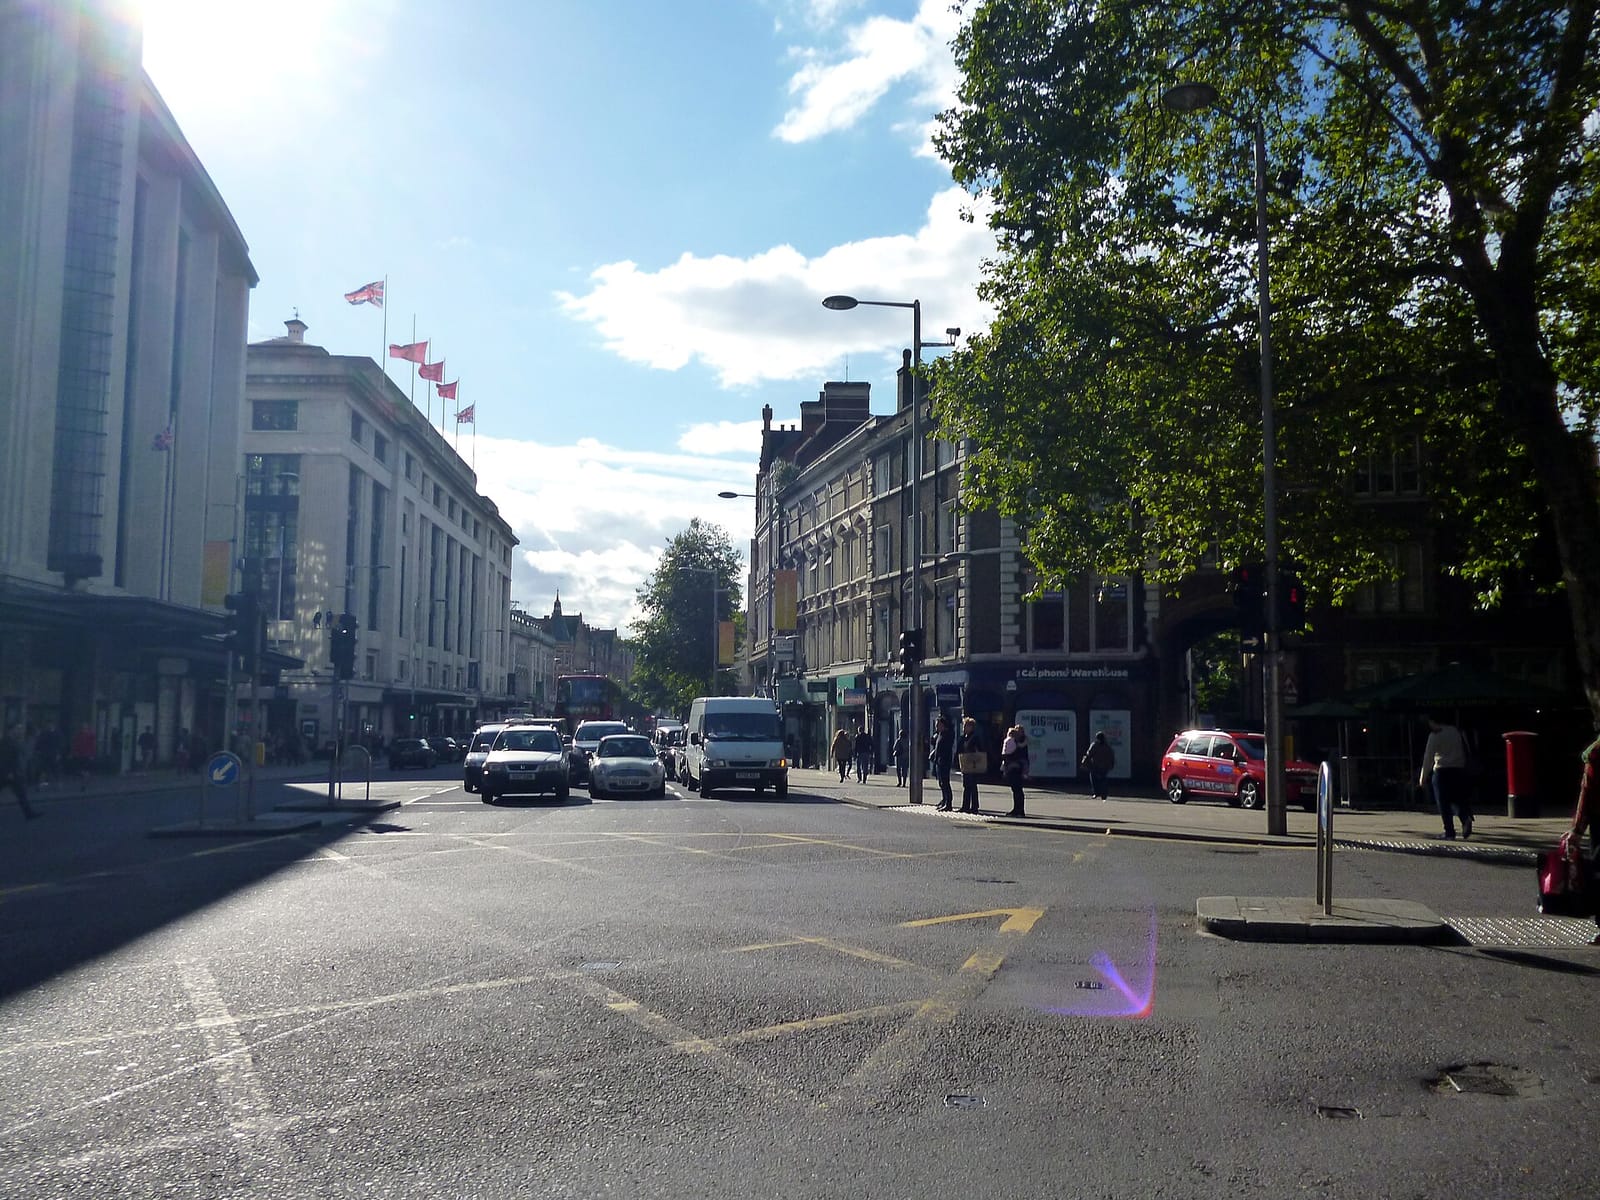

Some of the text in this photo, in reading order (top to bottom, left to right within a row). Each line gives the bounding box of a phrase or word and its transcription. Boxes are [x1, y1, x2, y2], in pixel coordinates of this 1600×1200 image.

[1071, 668, 1129, 678] Warehouse
[1030, 714, 1047, 727] BIG
[1053, 720, 1070, 732] YOU
